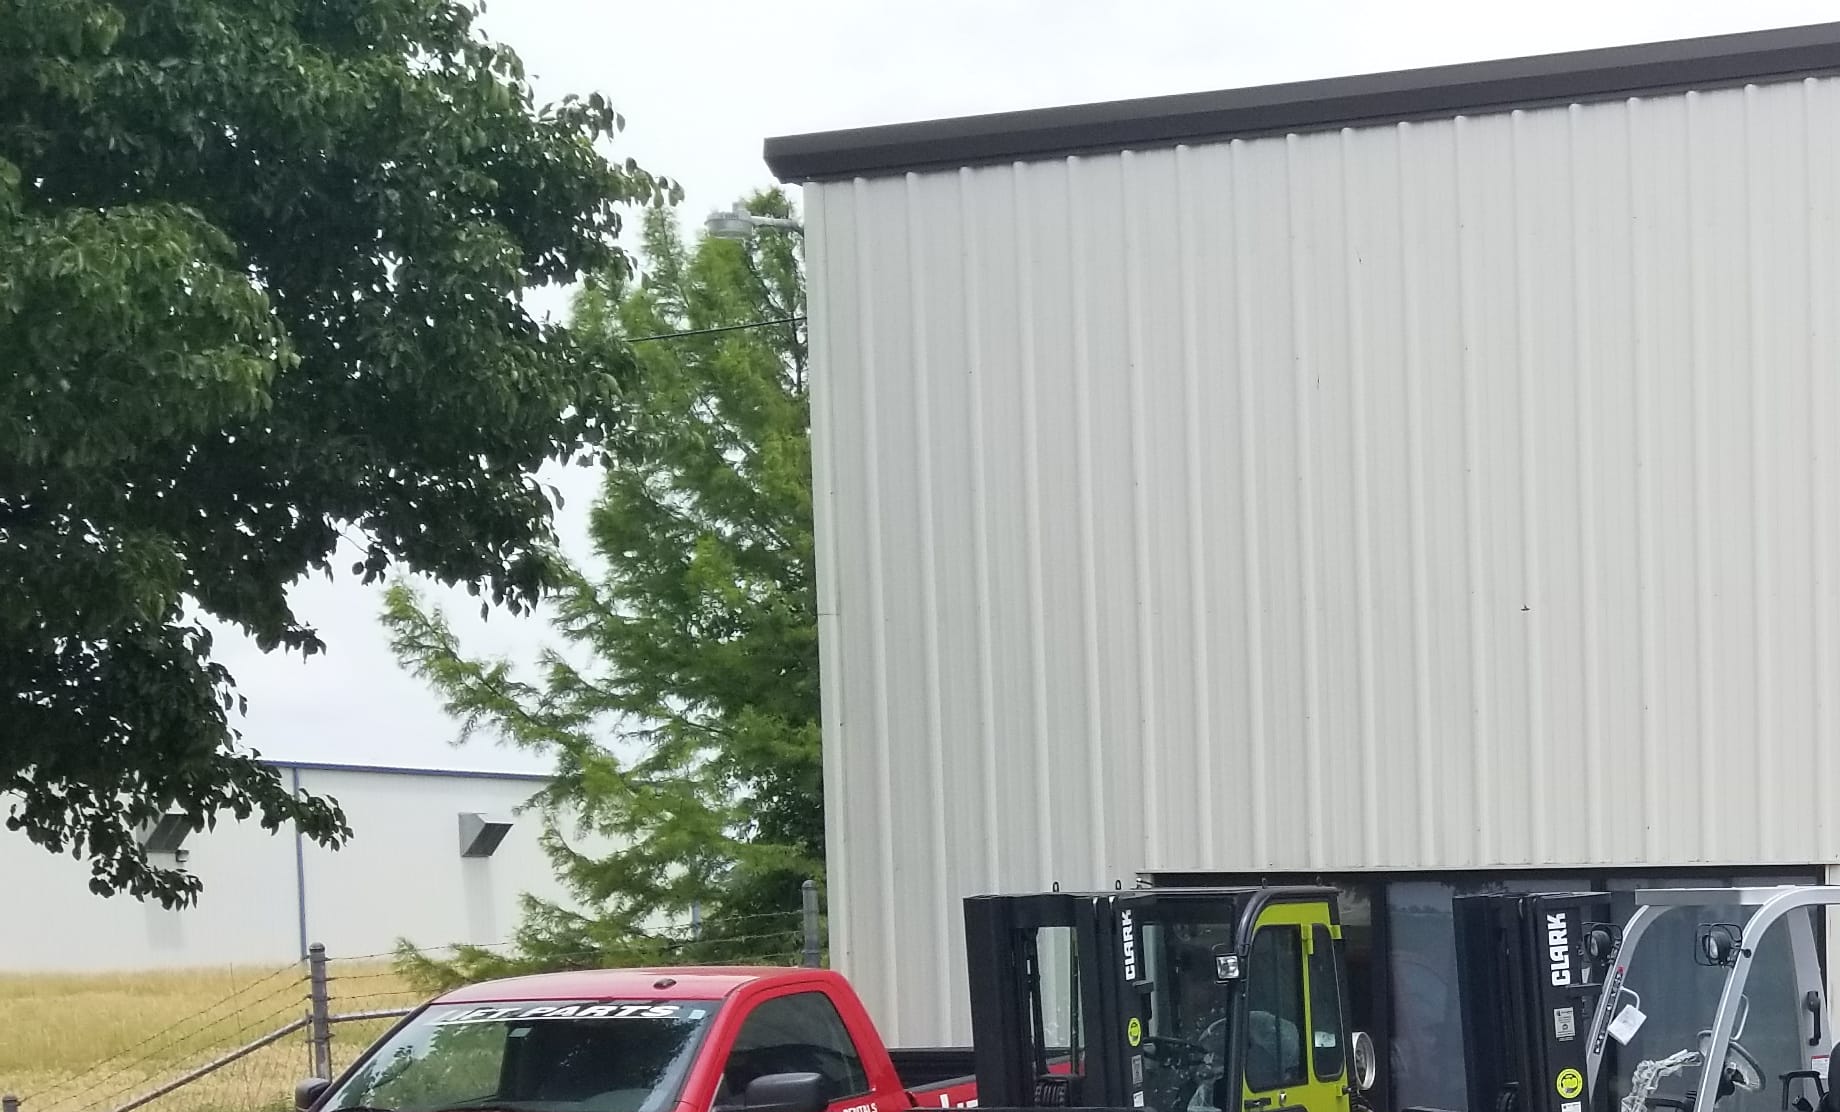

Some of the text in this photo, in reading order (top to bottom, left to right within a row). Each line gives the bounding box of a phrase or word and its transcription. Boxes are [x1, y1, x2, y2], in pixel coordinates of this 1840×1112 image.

[1121, 908, 1136, 981] CLARK
[1546, 912, 1571, 988] CLARK
[519, 1005, 680, 1017] PARTS
